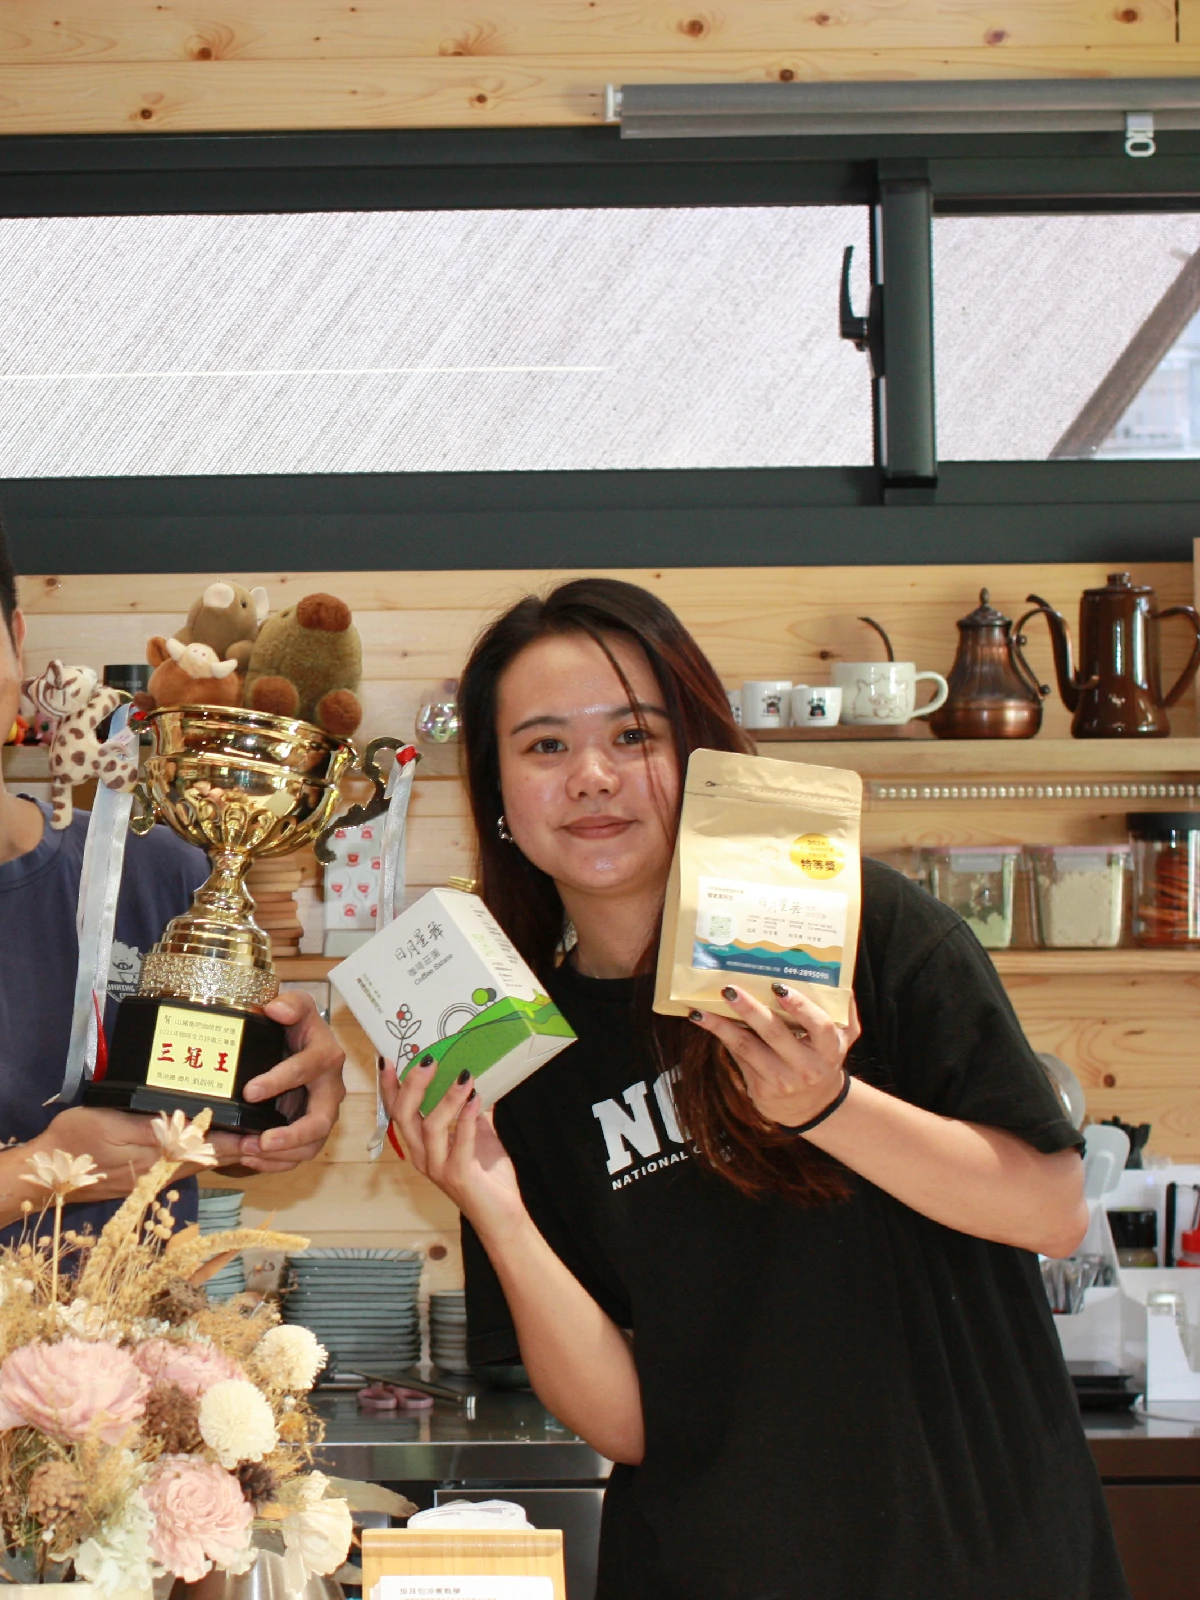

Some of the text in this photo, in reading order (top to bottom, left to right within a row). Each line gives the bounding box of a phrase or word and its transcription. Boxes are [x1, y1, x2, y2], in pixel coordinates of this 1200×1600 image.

[406, 947, 441, 977] 咖啡莊園
[413, 953, 453, 986] Coffee Estate
[156, 1042, 229, 1073] 三冠王
[611, 1150, 689, 1191] NATIONAL
